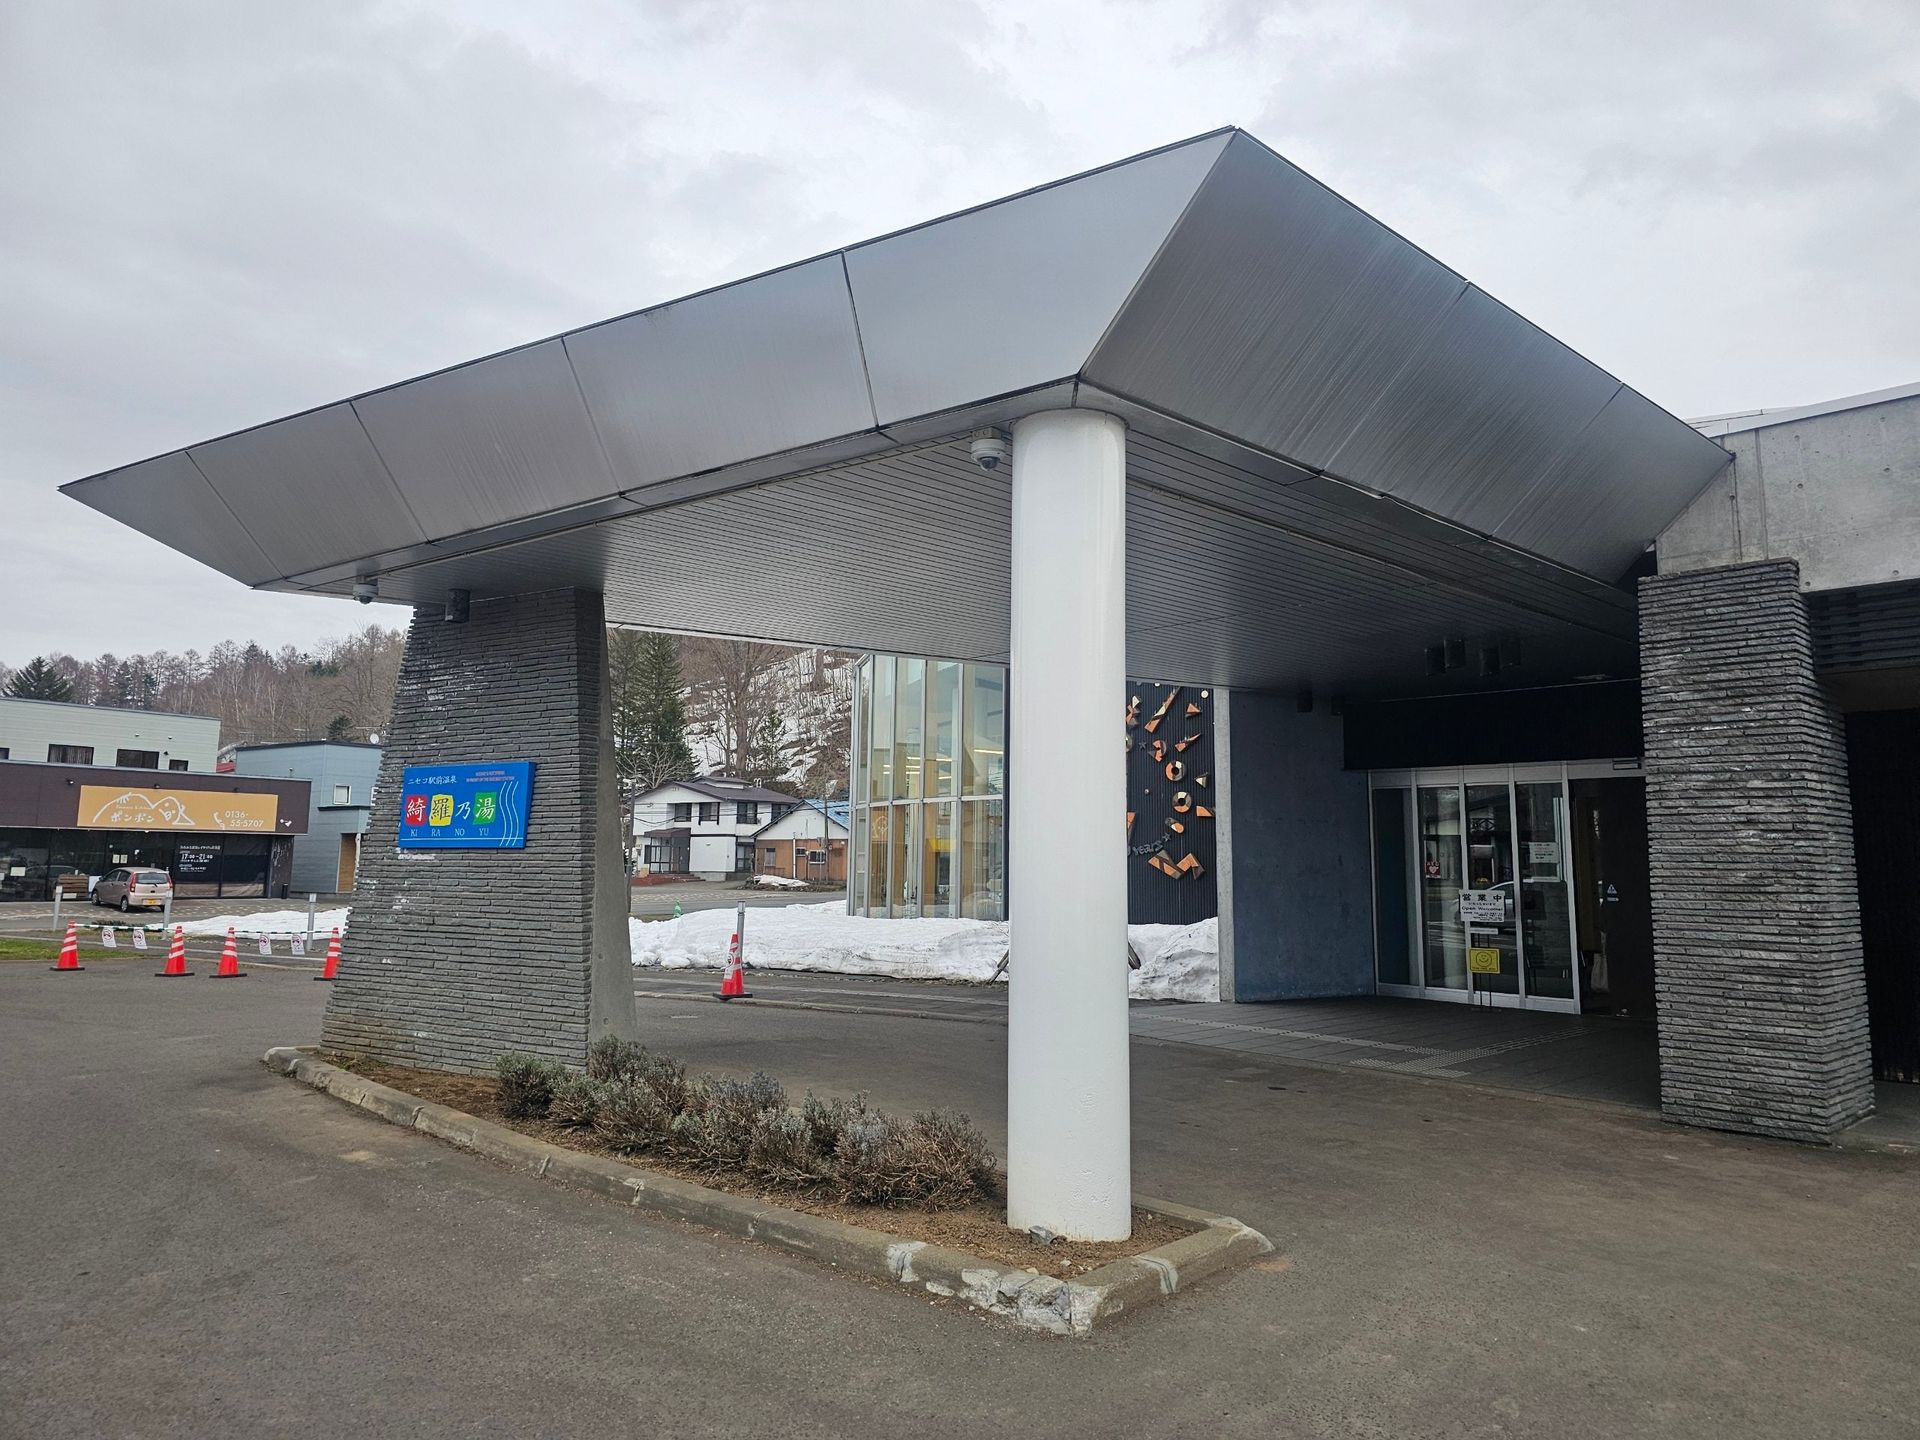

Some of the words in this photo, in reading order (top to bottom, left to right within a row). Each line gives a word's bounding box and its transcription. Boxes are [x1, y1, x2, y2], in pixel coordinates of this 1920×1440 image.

[408, 775, 458, 785] ニセコ駅前温泉
[406, 797, 497, 822] 綺羅乃湯
[410, 829, 418, 837] KI
[431, 829, 441, 837] RA
[454, 828, 465, 837] NO
[478, 828, 490, 837] YU
[1462, 893, 1502, 902] 営業中
